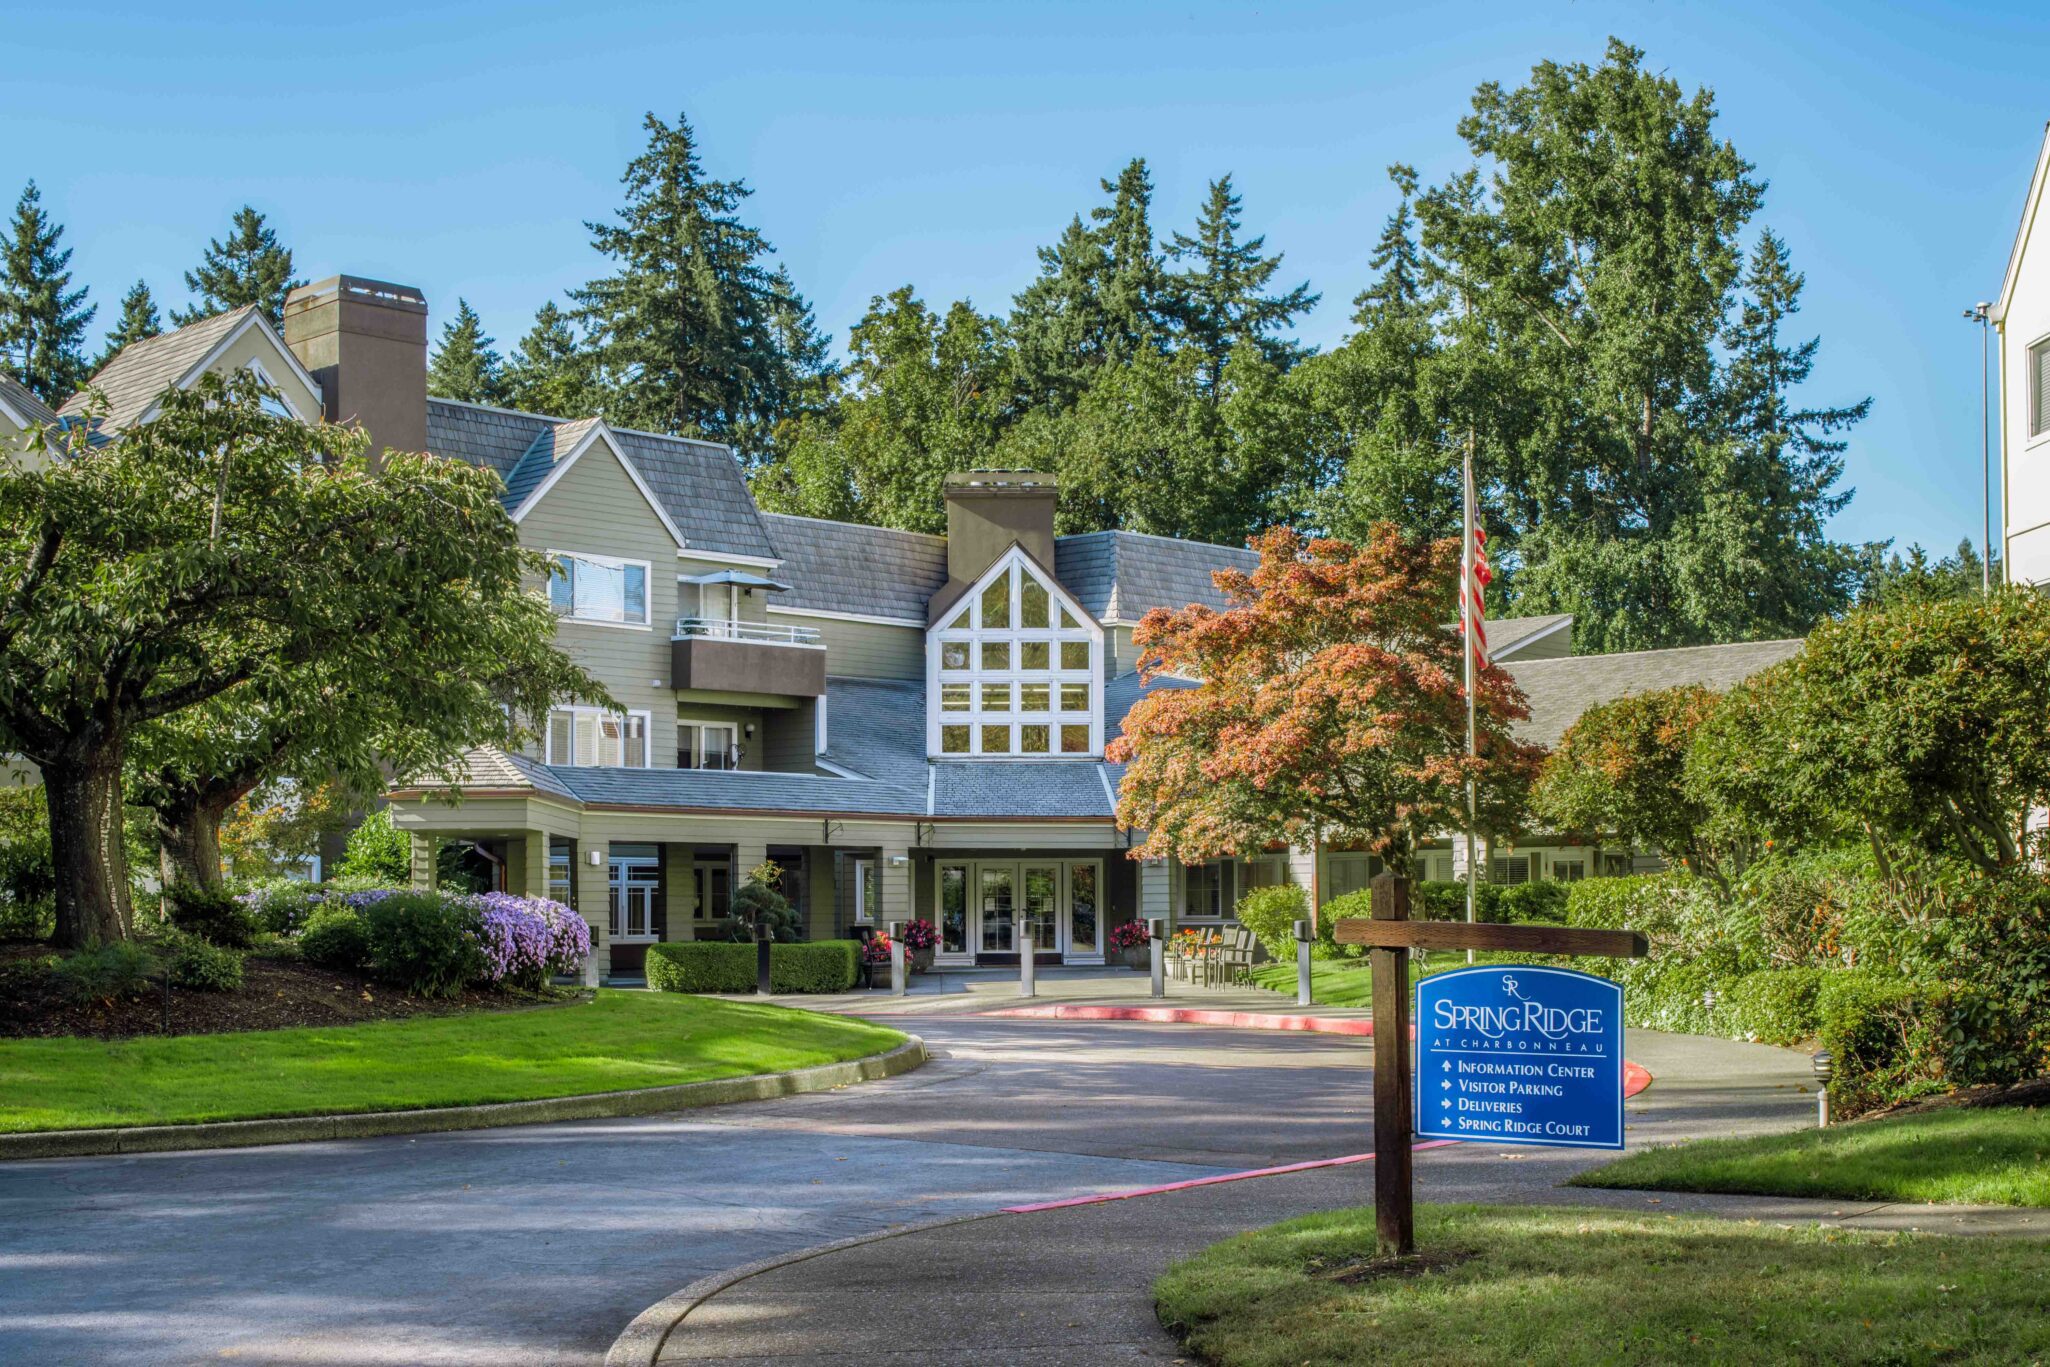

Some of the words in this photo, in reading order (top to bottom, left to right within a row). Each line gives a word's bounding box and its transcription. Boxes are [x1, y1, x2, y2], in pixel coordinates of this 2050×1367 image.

[1434, 1000, 1520, 1038] SPRING
[1523, 1002, 1603, 1040] RIDGE
[1434, 1038, 1451, 1047] AT
[1461, 1039, 1603, 1052] CHARBONNEAU
[1458, 1060, 1543, 1076] INFORMATION
[1548, 1064, 1594, 1078] CENTER
[1459, 1080, 1505, 1093] VISITOR
[1509, 1081, 1563, 1096] PARKING
[1459, 1098, 1522, 1113] DELIVERIES
[1458, 1117, 1501, 1131] SPRING
[1505, 1119, 1542, 1133] RIDGE
[1546, 1122, 1590, 1136] COURT
